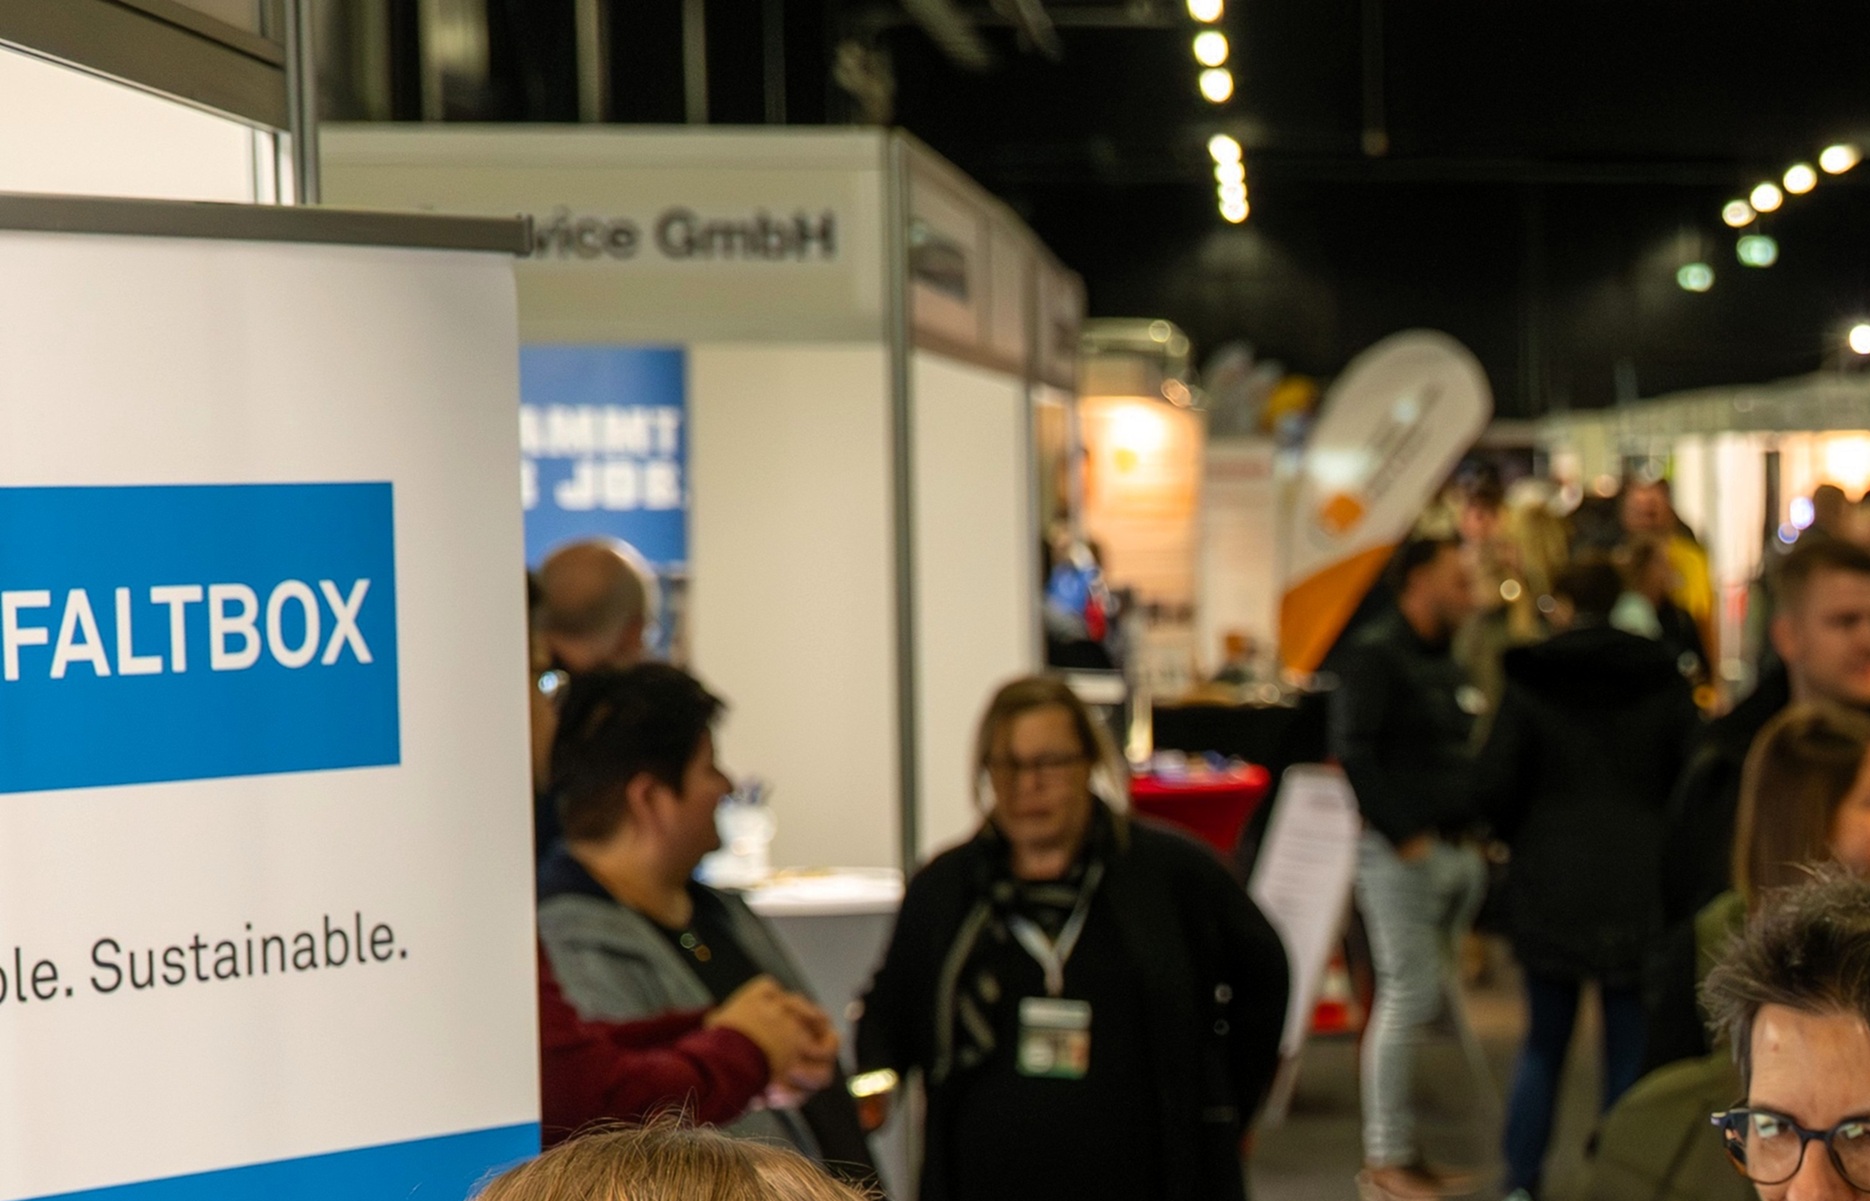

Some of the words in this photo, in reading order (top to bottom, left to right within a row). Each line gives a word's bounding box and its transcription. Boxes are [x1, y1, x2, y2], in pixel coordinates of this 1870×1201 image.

[655, 207, 837, 260] GmbH
[1, 578, 374, 682] FALTBOX
[91, 911, 408, 994] Sustainable.
